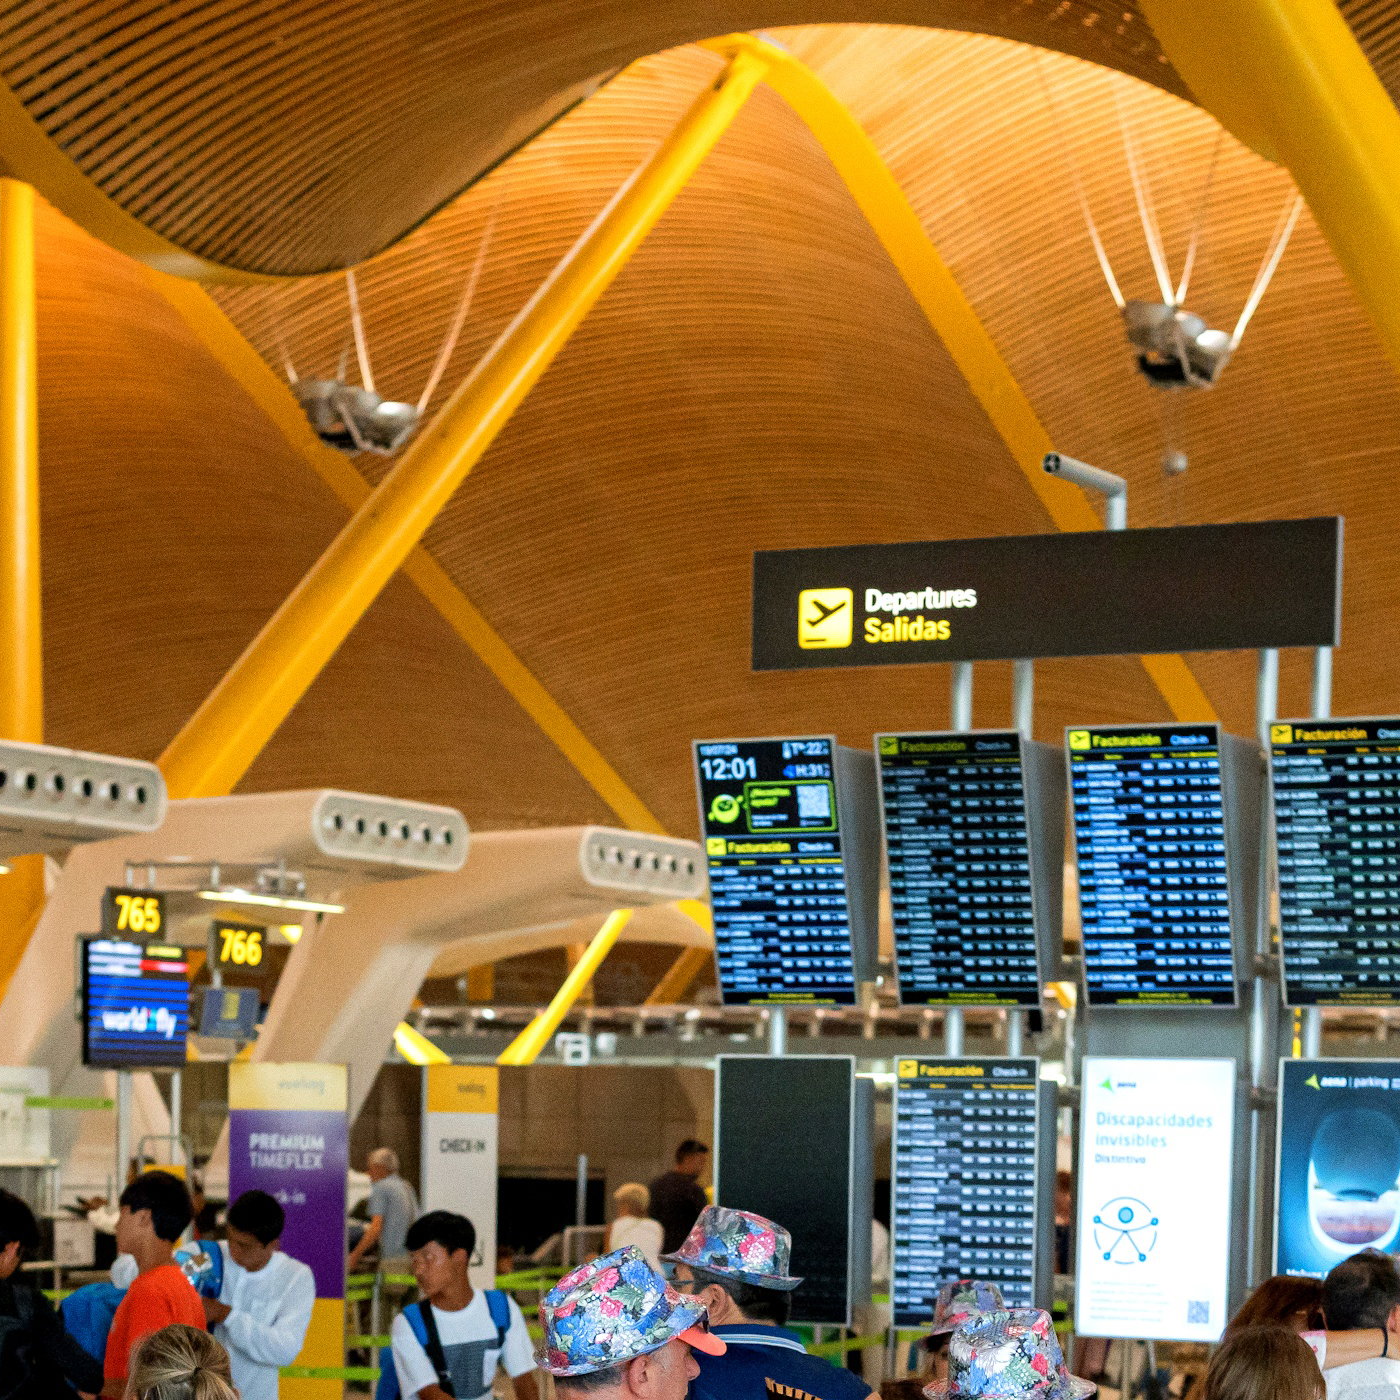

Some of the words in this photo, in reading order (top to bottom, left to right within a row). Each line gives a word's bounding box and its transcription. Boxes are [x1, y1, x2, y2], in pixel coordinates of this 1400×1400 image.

[864, 586, 978, 616] Departures
[863, 615, 952, 643] Salidas
[700, 757, 757, 780] 12:01
[115, 895, 161, 933] 765
[219, 928, 263, 966] 766
[1095, 1111, 1214, 1129] Discapacidades
[249, 1133, 325, 1151] PREMIUM
[438, 1138, 486, 1154] CHECK-IN
[1094, 1133, 1168, 1148] invisibles
[249, 1151, 325, 1170] TIMEFLEX
[1094, 1153, 1147, 1164] Distintivo
